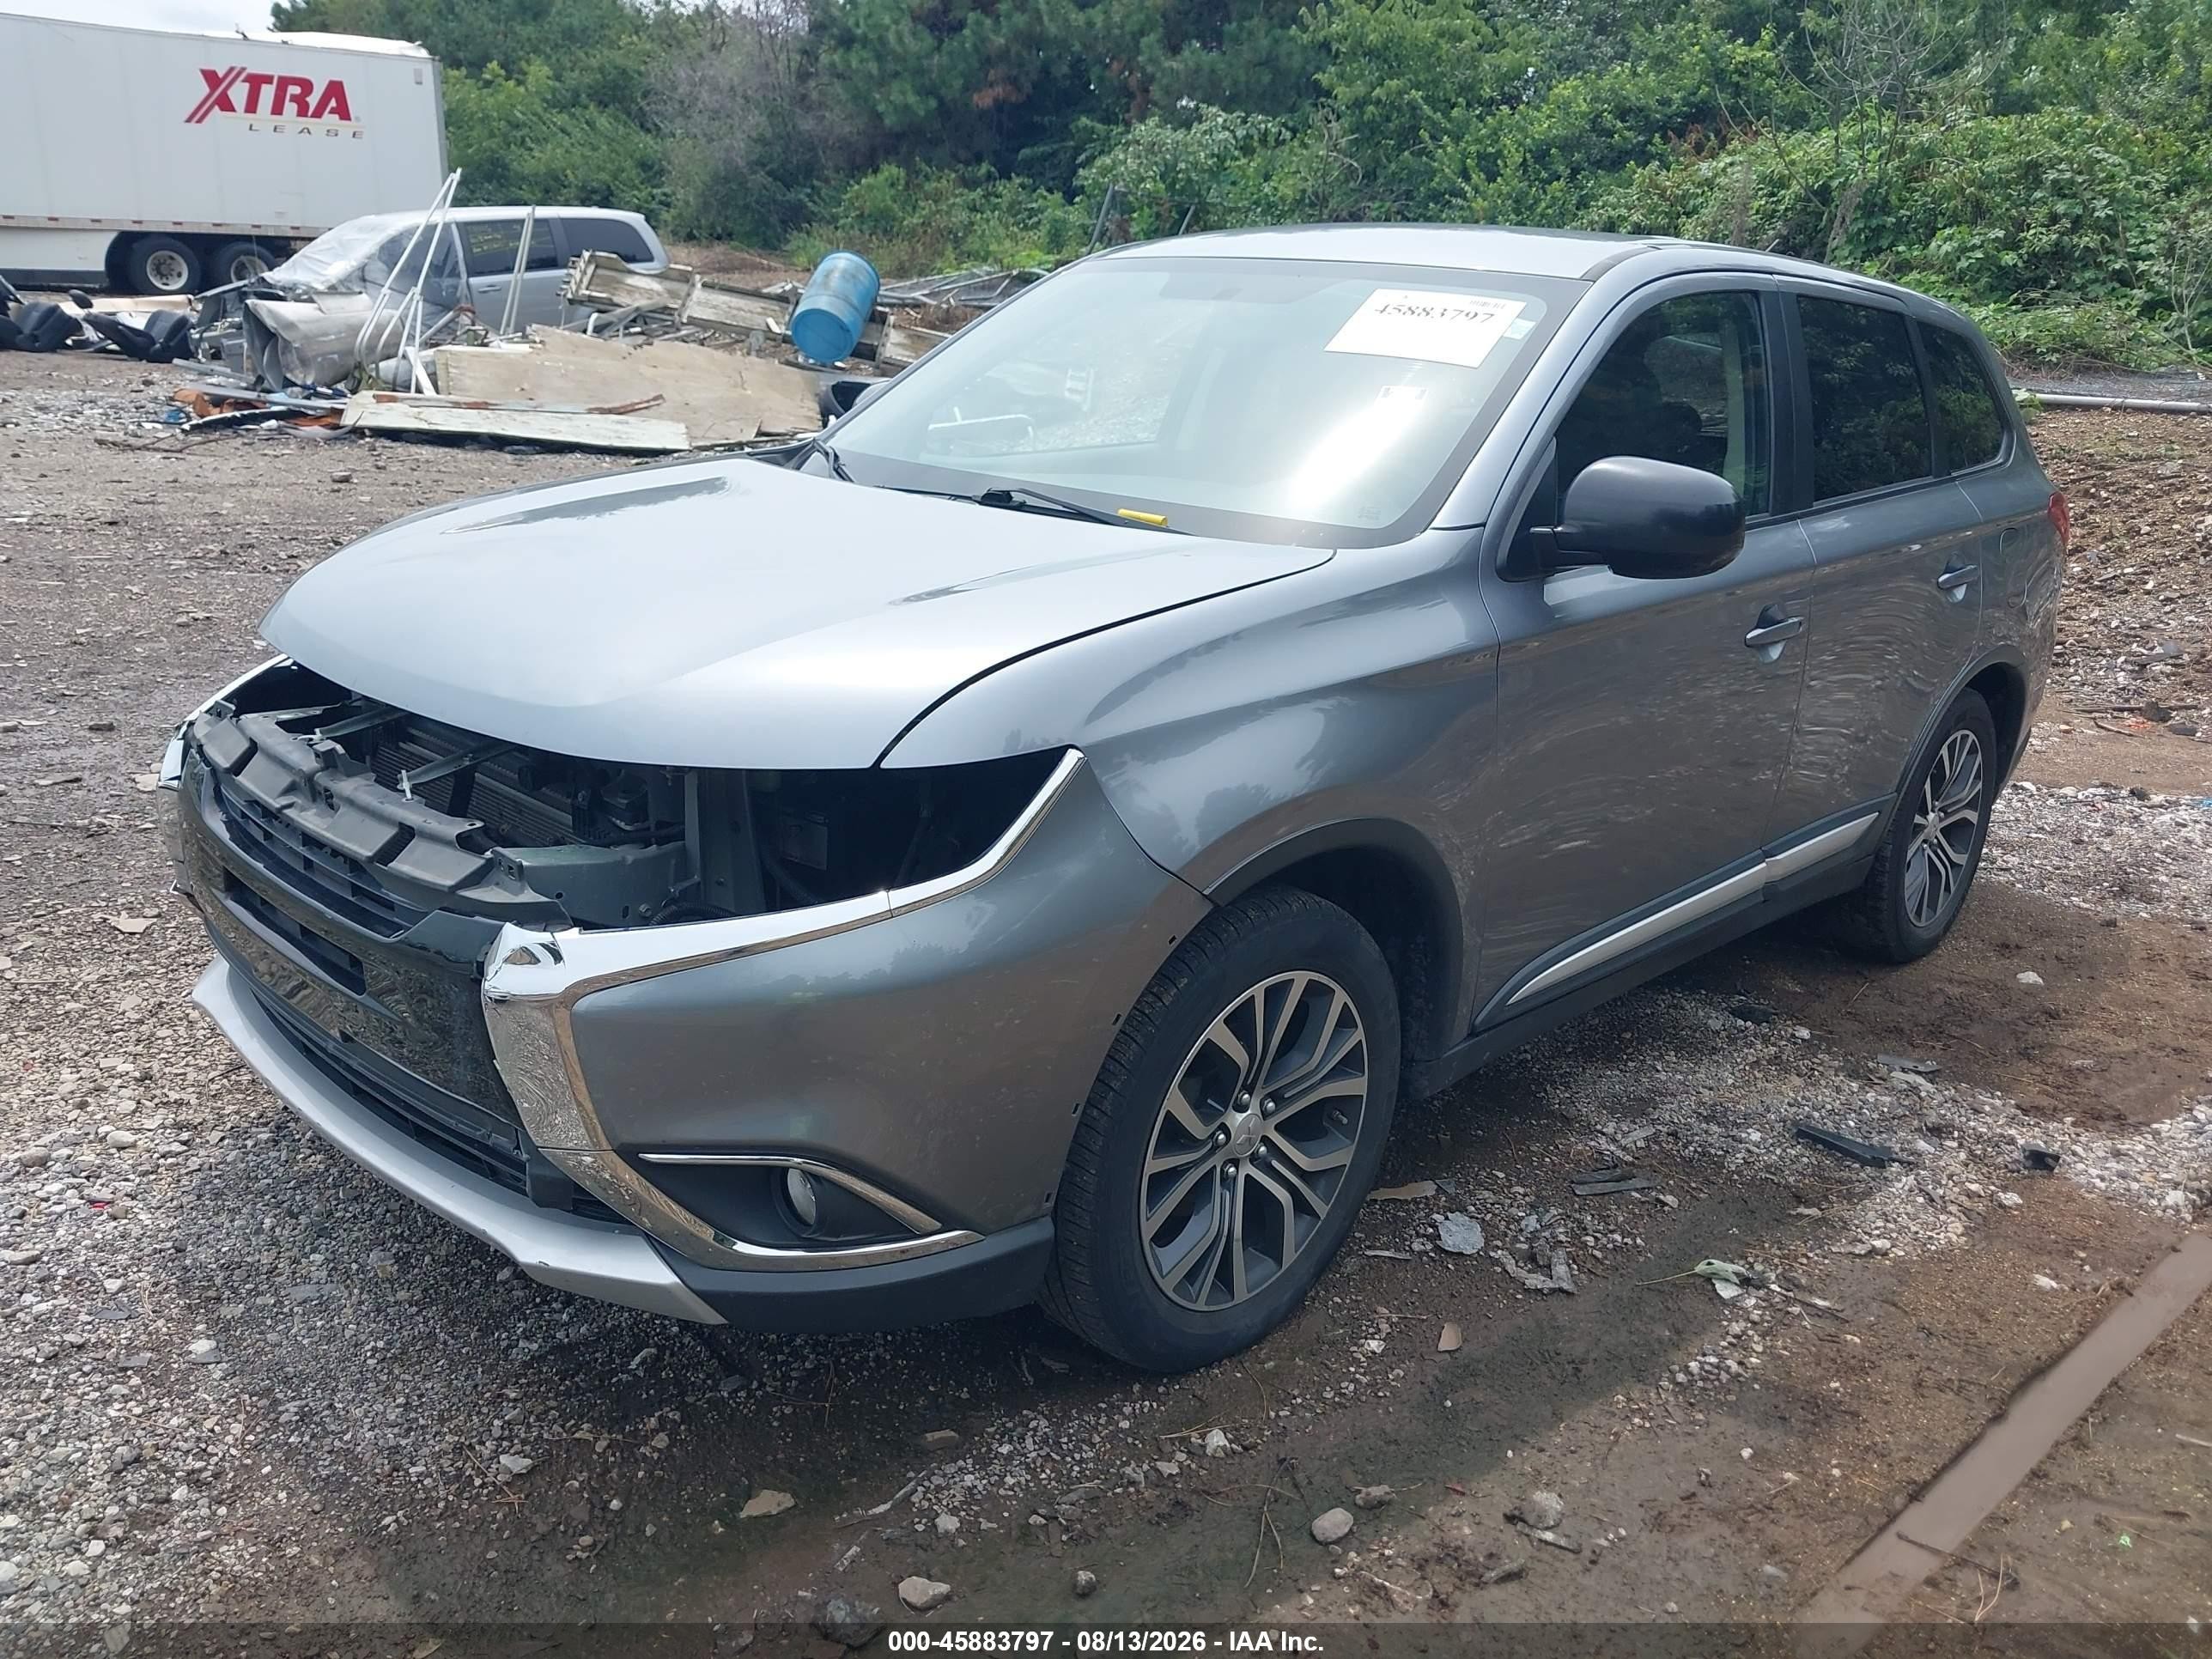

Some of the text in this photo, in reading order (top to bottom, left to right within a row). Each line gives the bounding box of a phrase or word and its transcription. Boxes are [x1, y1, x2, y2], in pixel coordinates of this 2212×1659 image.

[184, 66, 352, 124] XTRA
[248, 123, 364, 139] LEASE
[1375, 303, 1496, 324] 45883797
